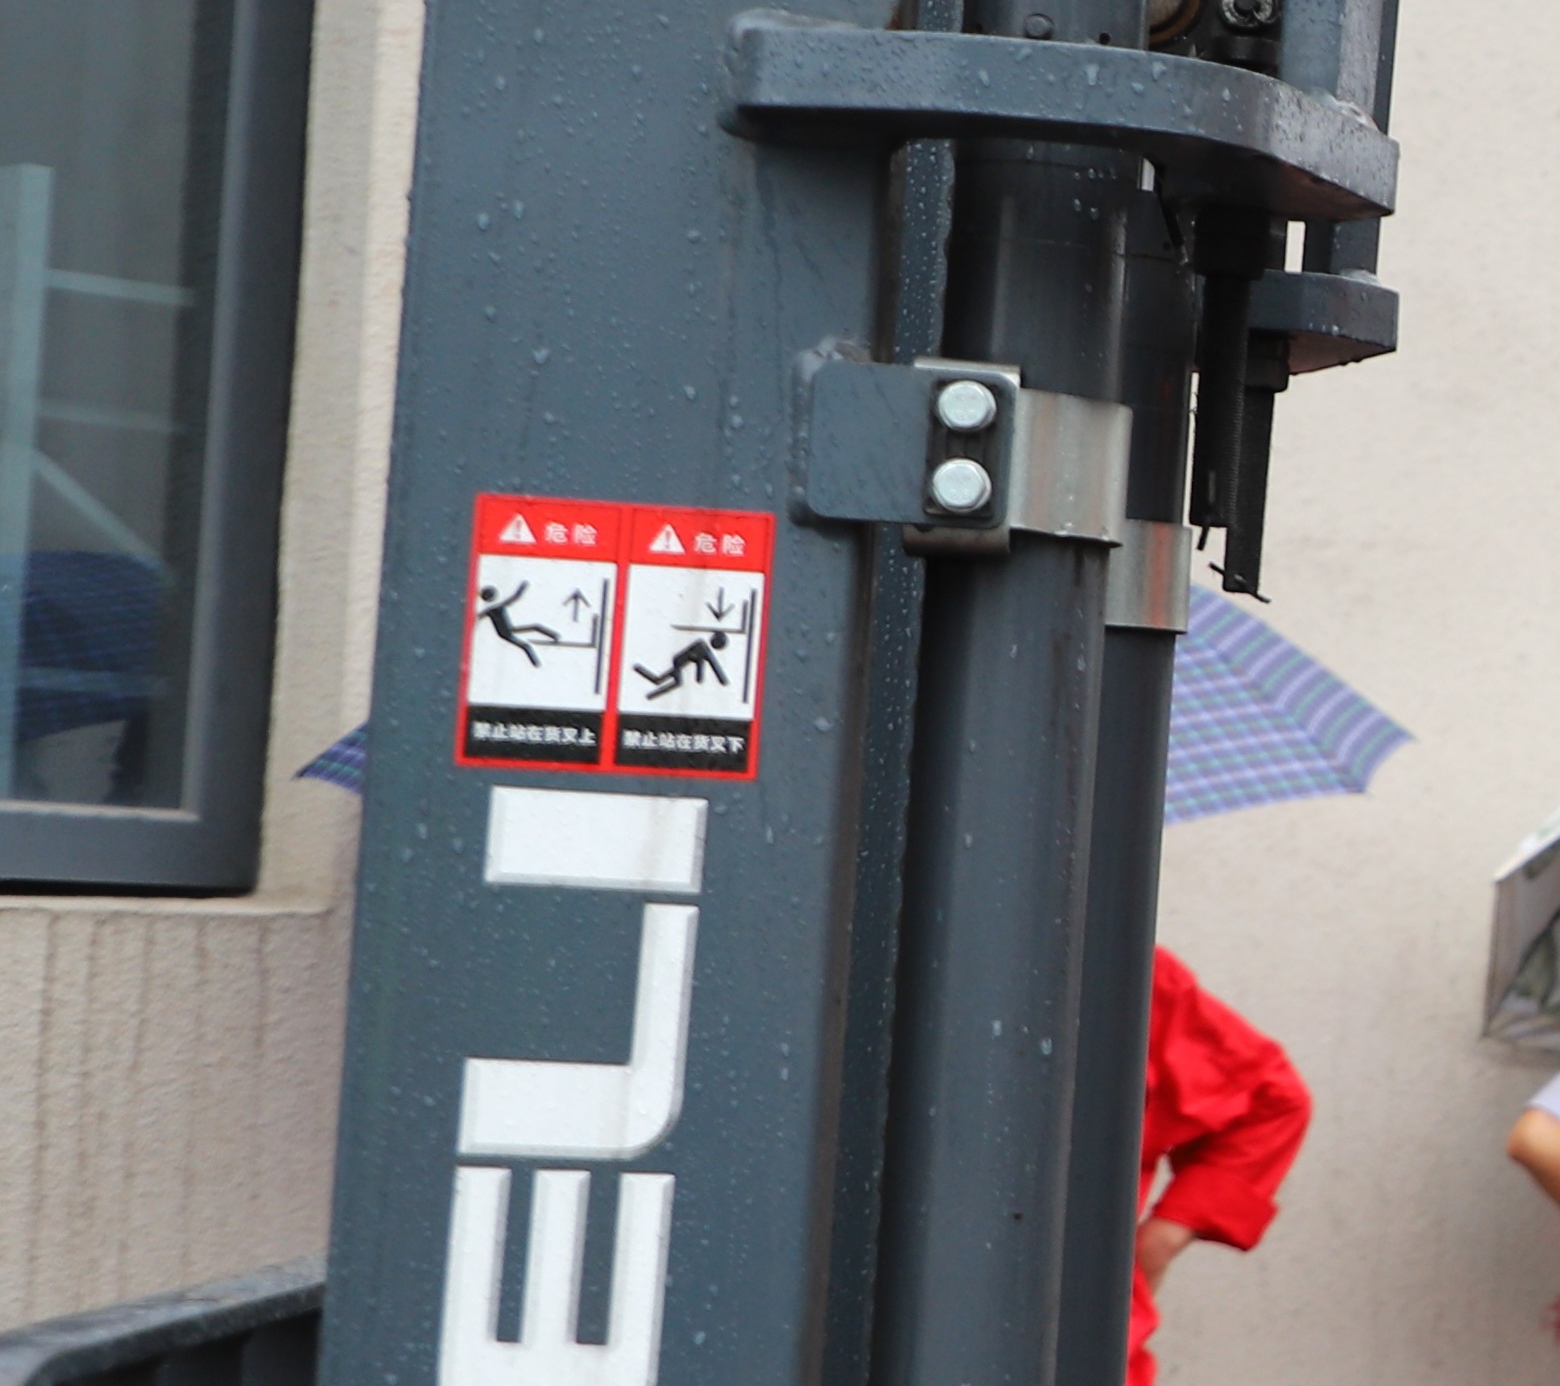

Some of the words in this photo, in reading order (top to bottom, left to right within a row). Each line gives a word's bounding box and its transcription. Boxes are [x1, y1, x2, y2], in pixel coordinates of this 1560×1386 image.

[543, 522, 598, 546] 危险
[693, 532, 746, 556] 危险
[473, 720, 596, 745] 禁止站在货叉上
[623, 731, 746, 755] 禁止站在货叉下
